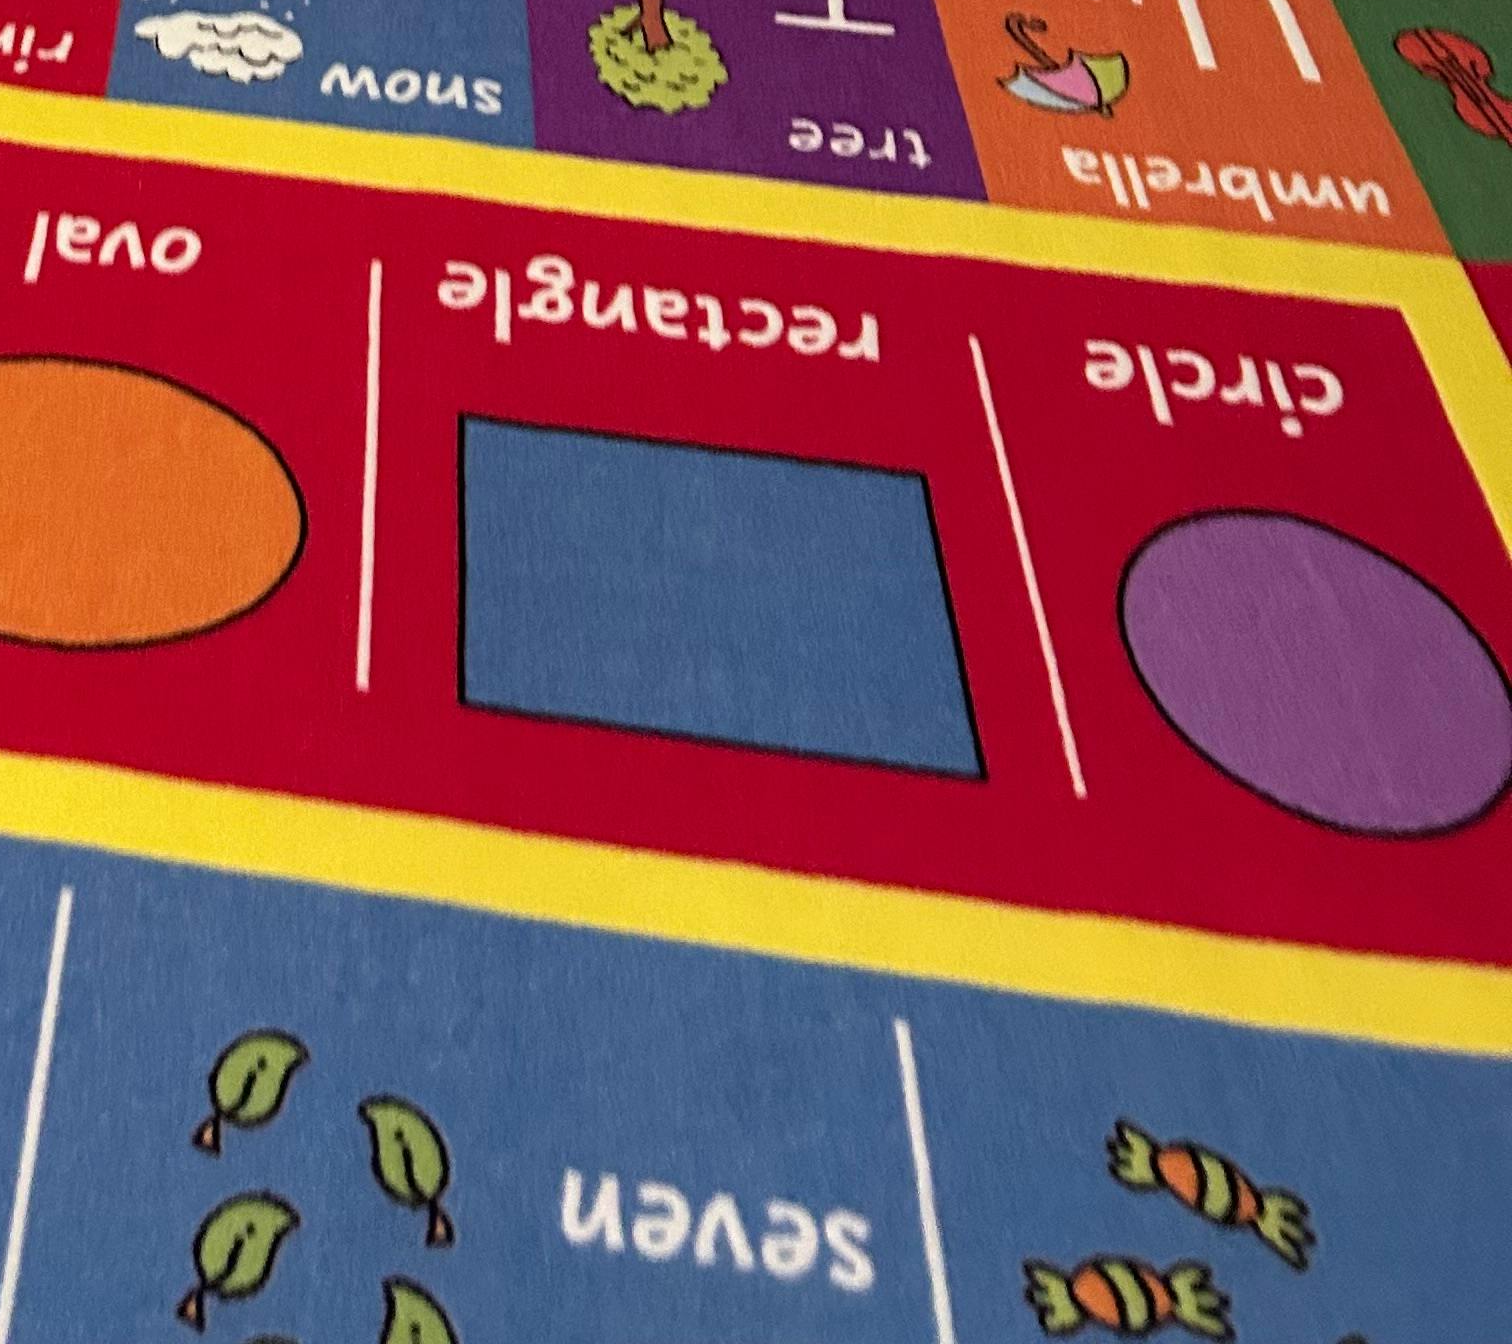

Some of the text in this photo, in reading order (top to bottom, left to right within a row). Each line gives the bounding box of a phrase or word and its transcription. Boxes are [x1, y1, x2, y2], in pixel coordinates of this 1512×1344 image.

[321, 62, 503, 116] snow
[787, 116, 931, 170] tree
[1061, 145, 1391, 224] umbrella
[23, 210, 204, 284] oval
[436, 254, 880, 364] rectangle
[1082, 336, 1346, 438] circle
[560, 1165, 875, 1294] seven
